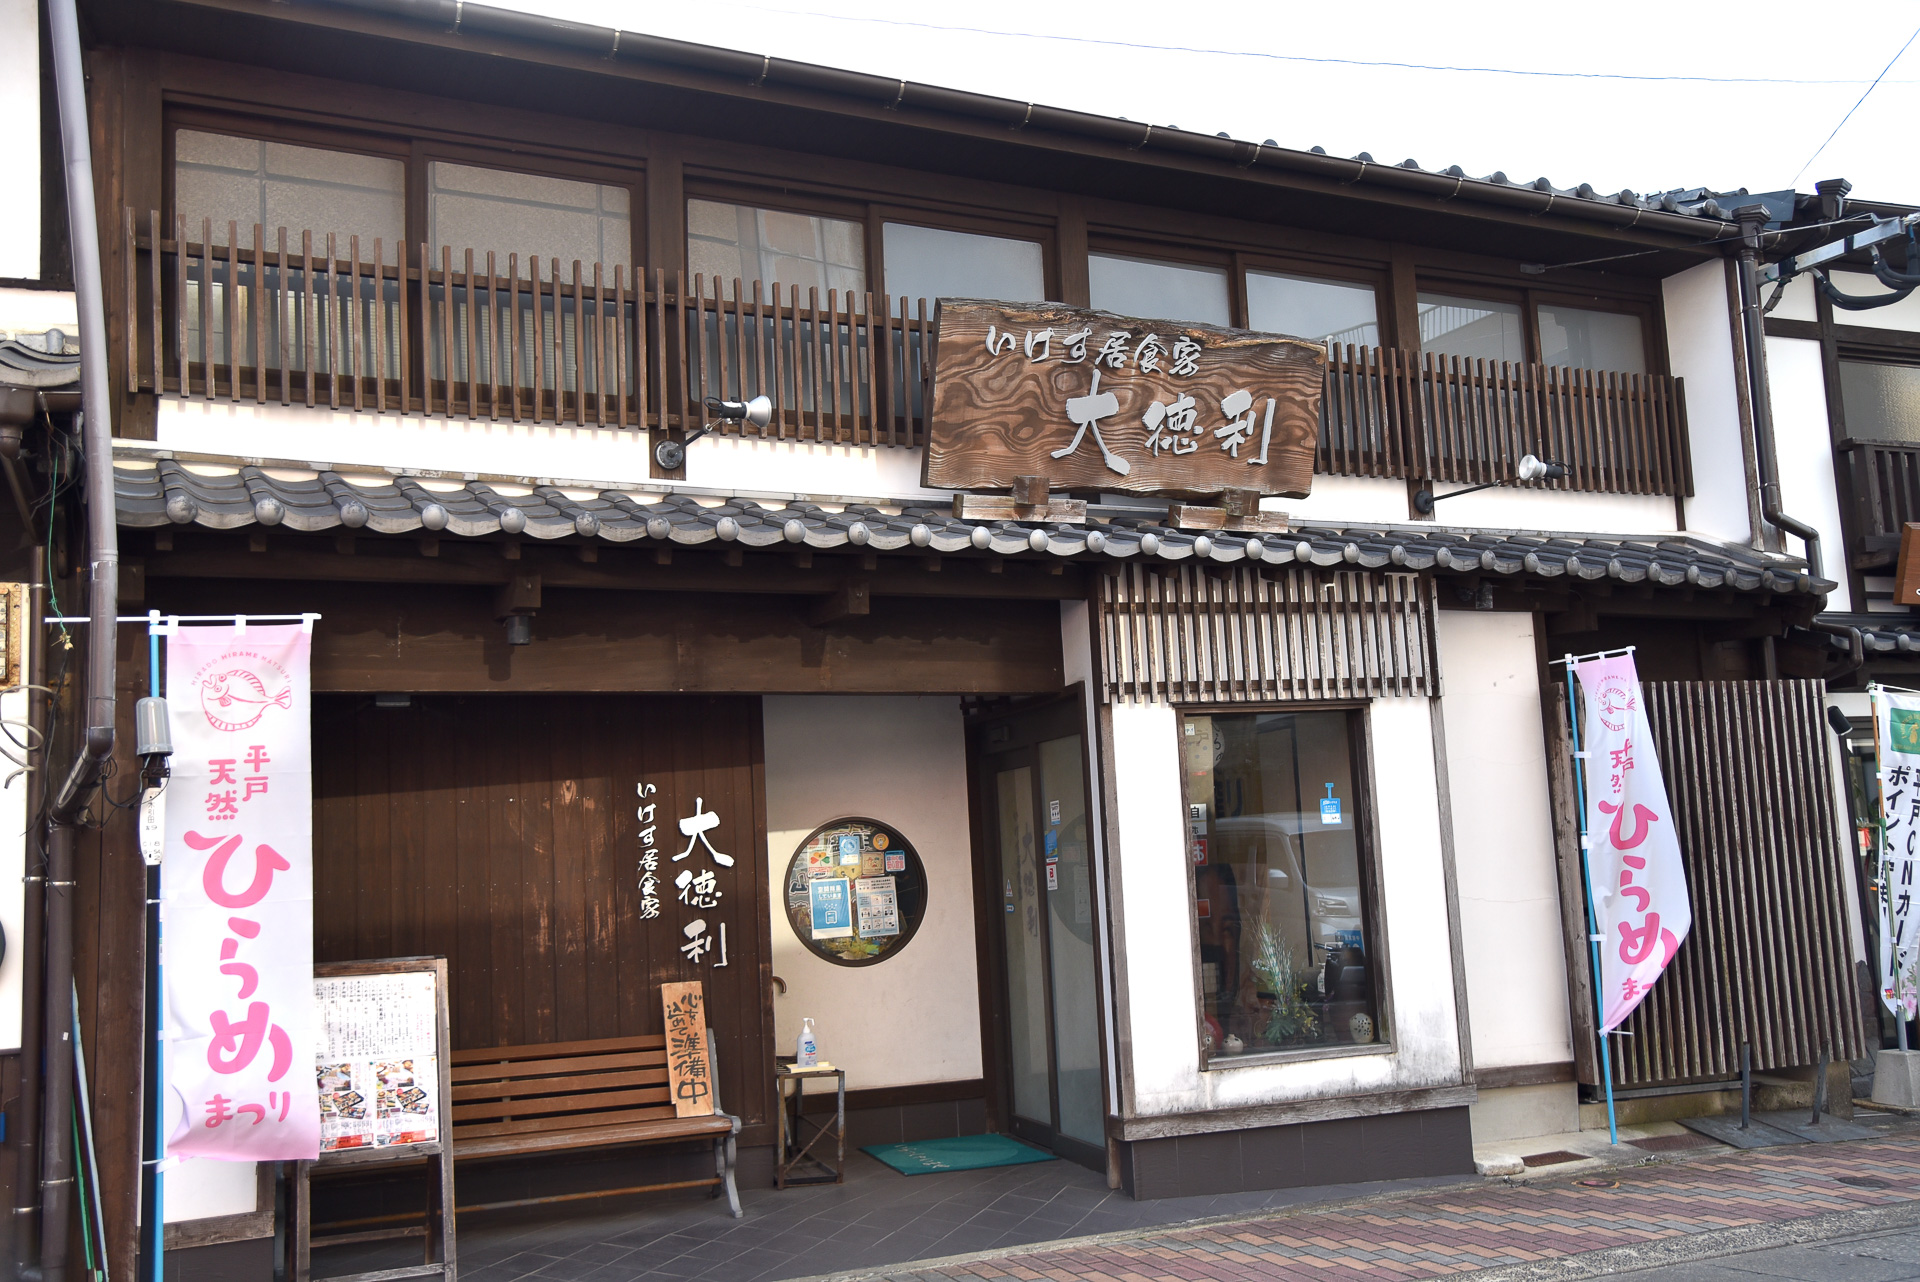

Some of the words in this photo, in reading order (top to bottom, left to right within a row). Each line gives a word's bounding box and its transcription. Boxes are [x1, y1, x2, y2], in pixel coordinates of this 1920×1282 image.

[985, 325, 1202, 377] いけす居食家
[1050, 368, 1275, 476] 大徳利
[221, 651, 258, 660] HIRAME
[261, 656, 292, 683] MATSURI
[204, 758, 238, 821] 天然
[242, 744, 271, 802] 平戸
[636, 782, 661, 920] いけす居食家
[671, 796, 735, 968] 大徳利
[1598, 799, 1679, 969] ひらめ
[184, 829, 293, 1083] ひらめ
[666, 1001, 689, 1036] 込めて
[681, 992, 702, 1026] 心を
[670, 1031, 708, 1105] 準備中
[204, 1091, 292, 1129] まつり
